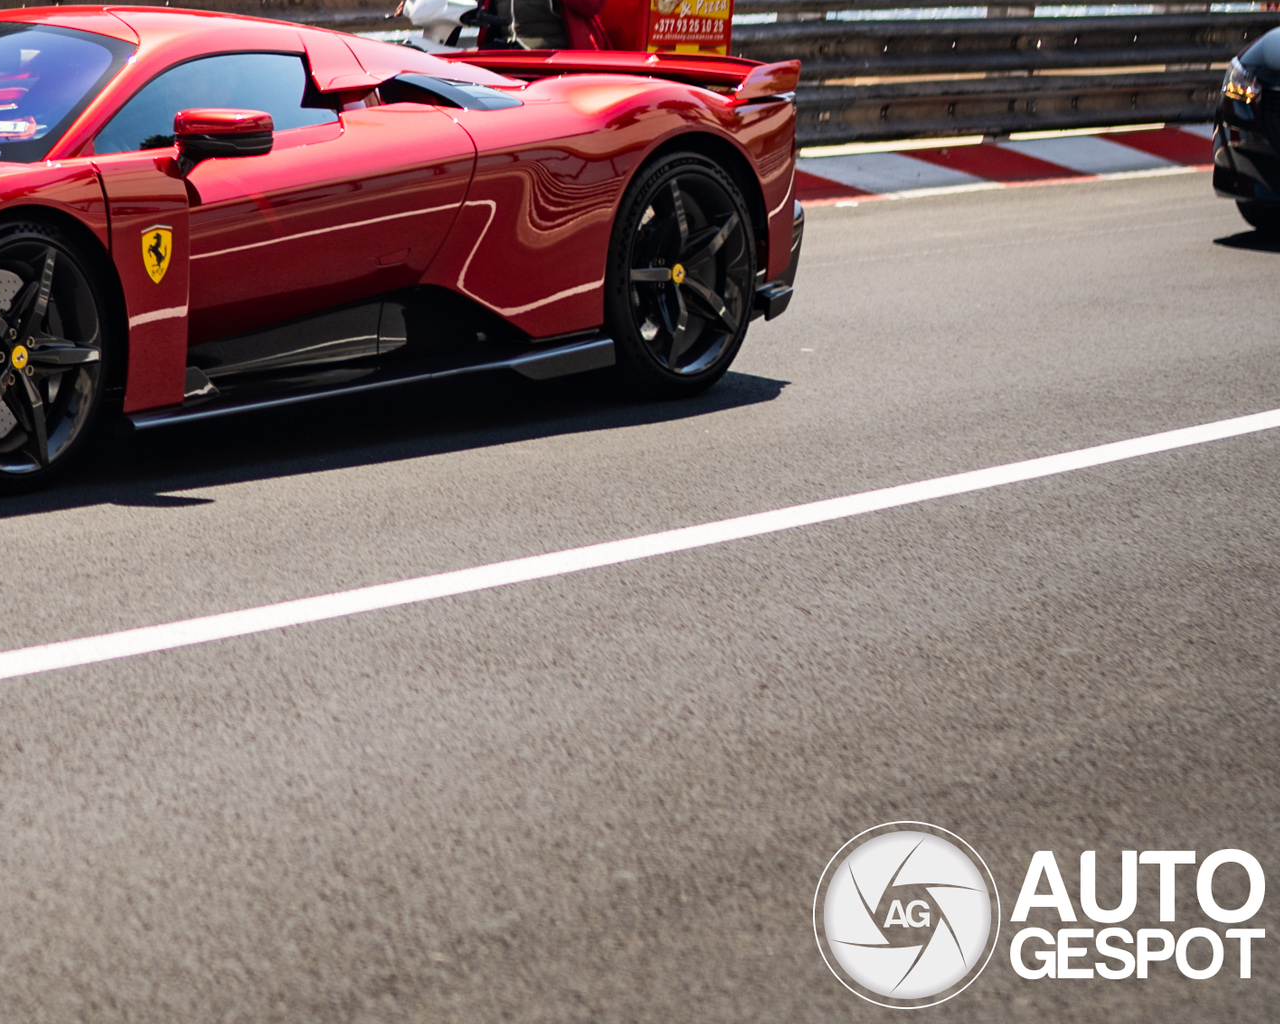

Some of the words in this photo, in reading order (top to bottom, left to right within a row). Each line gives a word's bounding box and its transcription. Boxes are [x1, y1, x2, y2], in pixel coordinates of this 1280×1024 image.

[680, 1, 692, 18] &
[654, 18, 675, 33] +377
[676, 18, 688, 33] 93
[689, 19, 700, 33] 25
[701, 19, 712, 33] 10
[713, 19, 724, 33] 25
